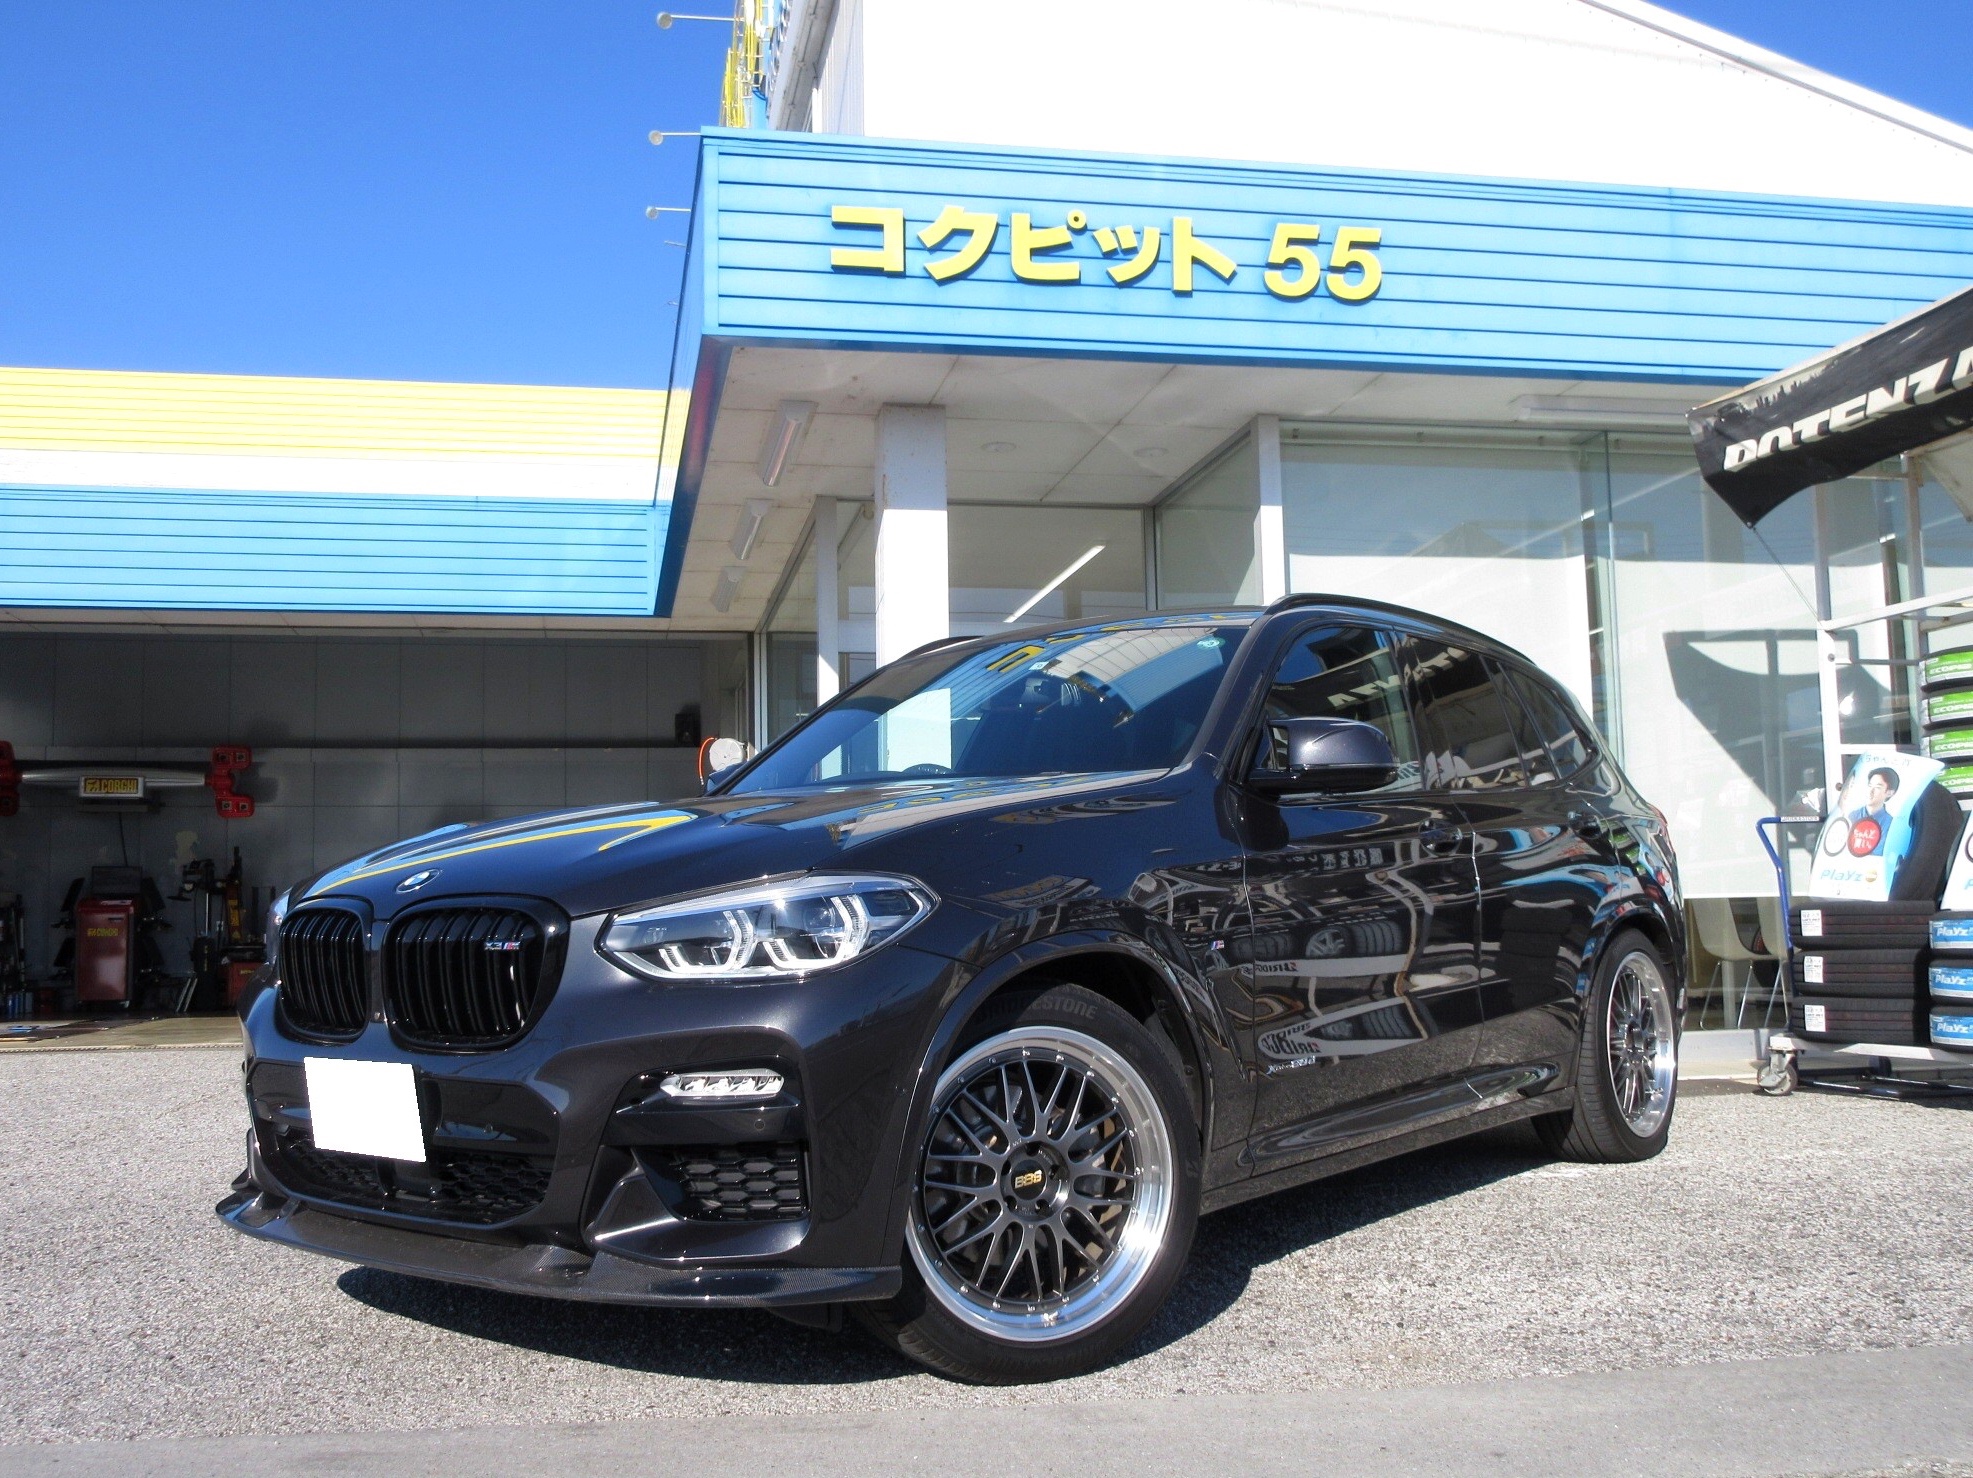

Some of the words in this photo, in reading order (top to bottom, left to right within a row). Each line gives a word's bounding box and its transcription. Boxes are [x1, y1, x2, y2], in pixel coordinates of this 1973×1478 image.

[831, 205, 1237, 295] コクピット
[1263, 222, 1383, 301] 55
[100, 779, 137, 793] CORGHI
[1820, 868, 1864, 882] Playz
[1015, 1169, 1042, 1189] BBS
